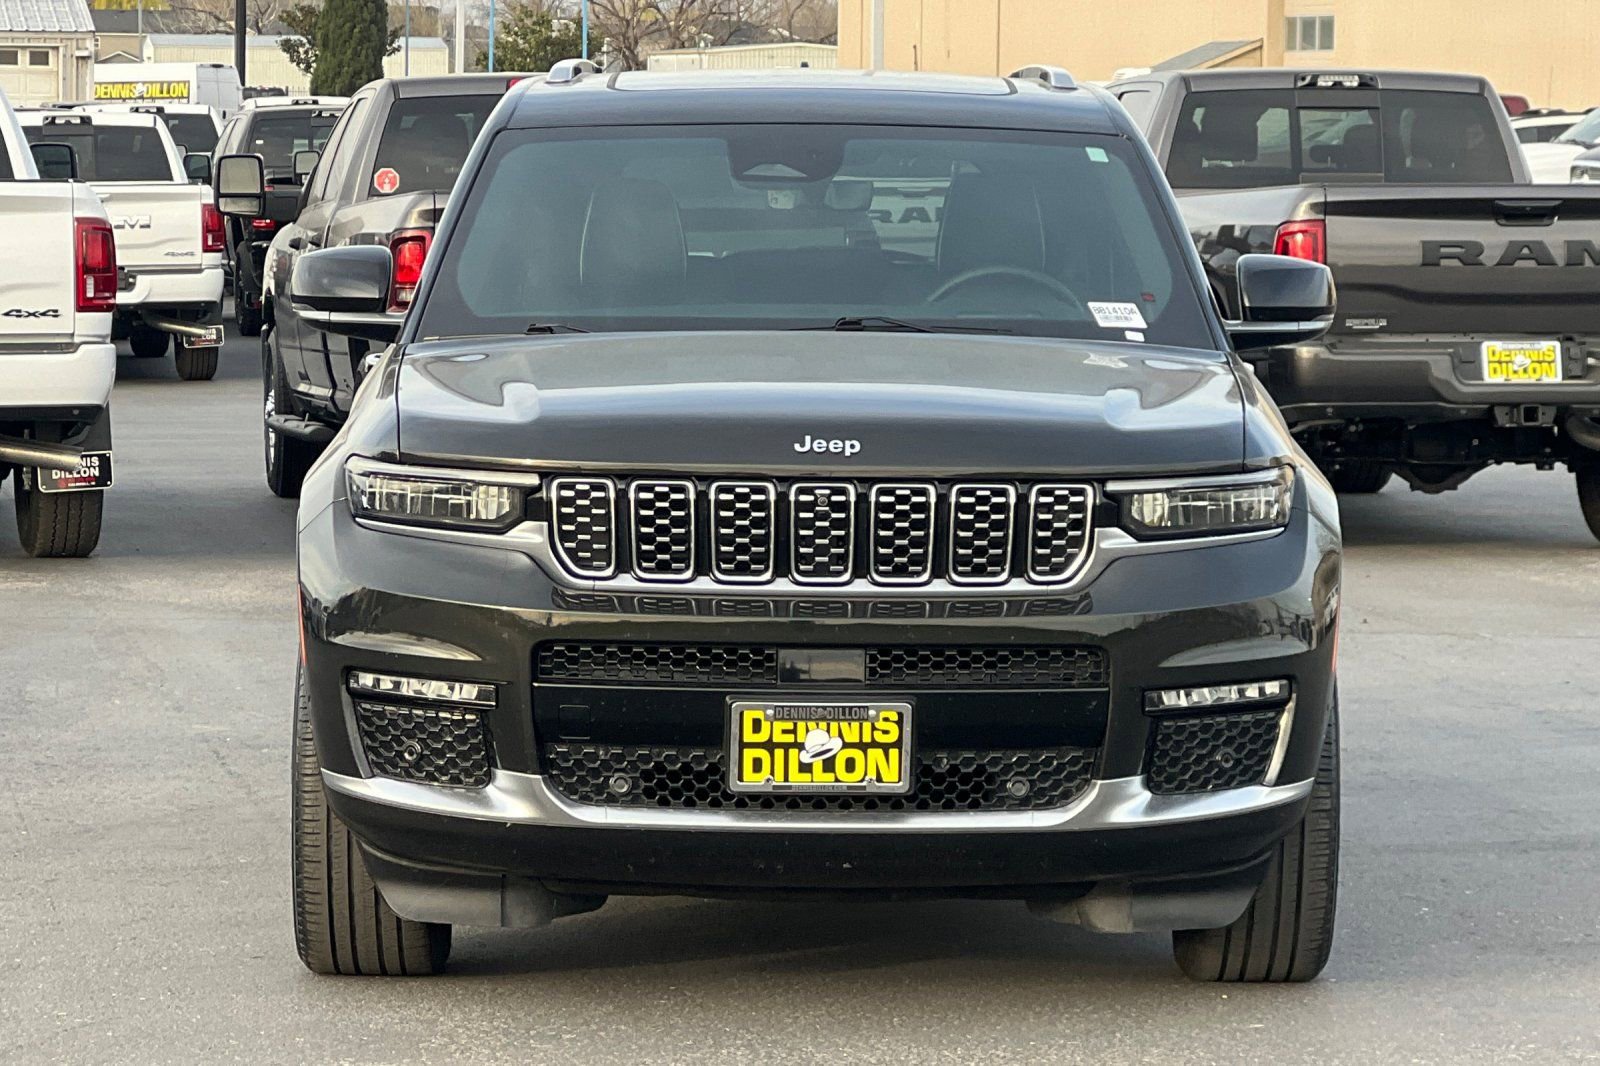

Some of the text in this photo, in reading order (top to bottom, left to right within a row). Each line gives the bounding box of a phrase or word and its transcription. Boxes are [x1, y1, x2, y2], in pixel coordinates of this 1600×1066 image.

[144, 82, 188, 97] DILLON
[1488, 362, 1556, 378] DILLON
[793, 435, 861, 457] Jeep
[78, 457, 99, 467] NIS
[775, 707, 868, 719] DENNIS DILLON
[743, 748, 899, 782] DILLON
